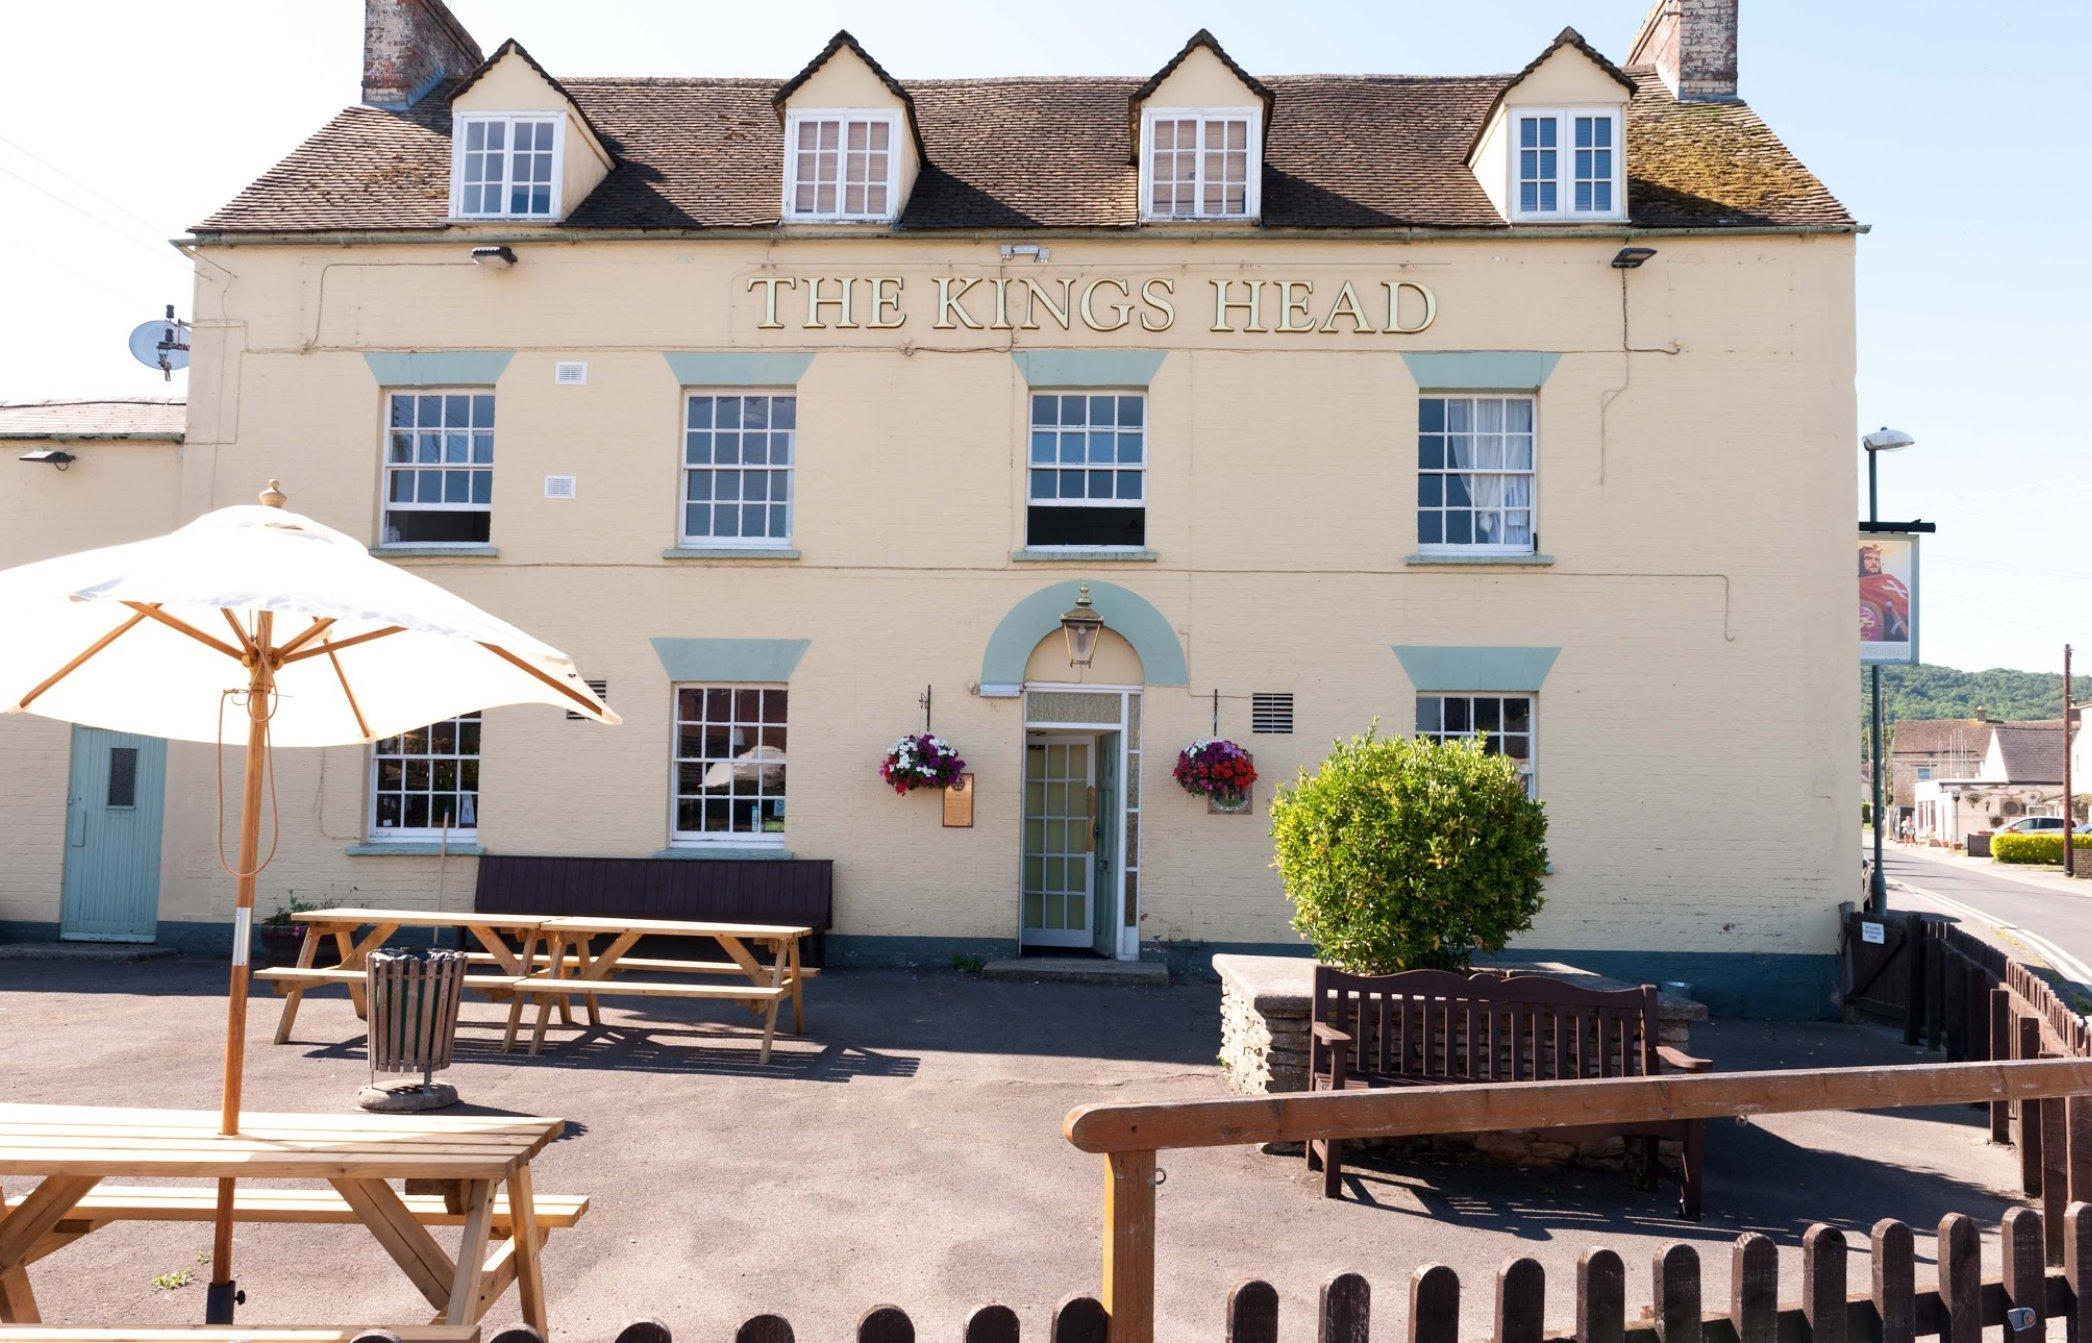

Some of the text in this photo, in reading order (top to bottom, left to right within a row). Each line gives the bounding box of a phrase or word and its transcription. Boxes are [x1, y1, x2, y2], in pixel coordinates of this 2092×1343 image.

[747, 276, 1438, 334] THE KINGS HEAD
